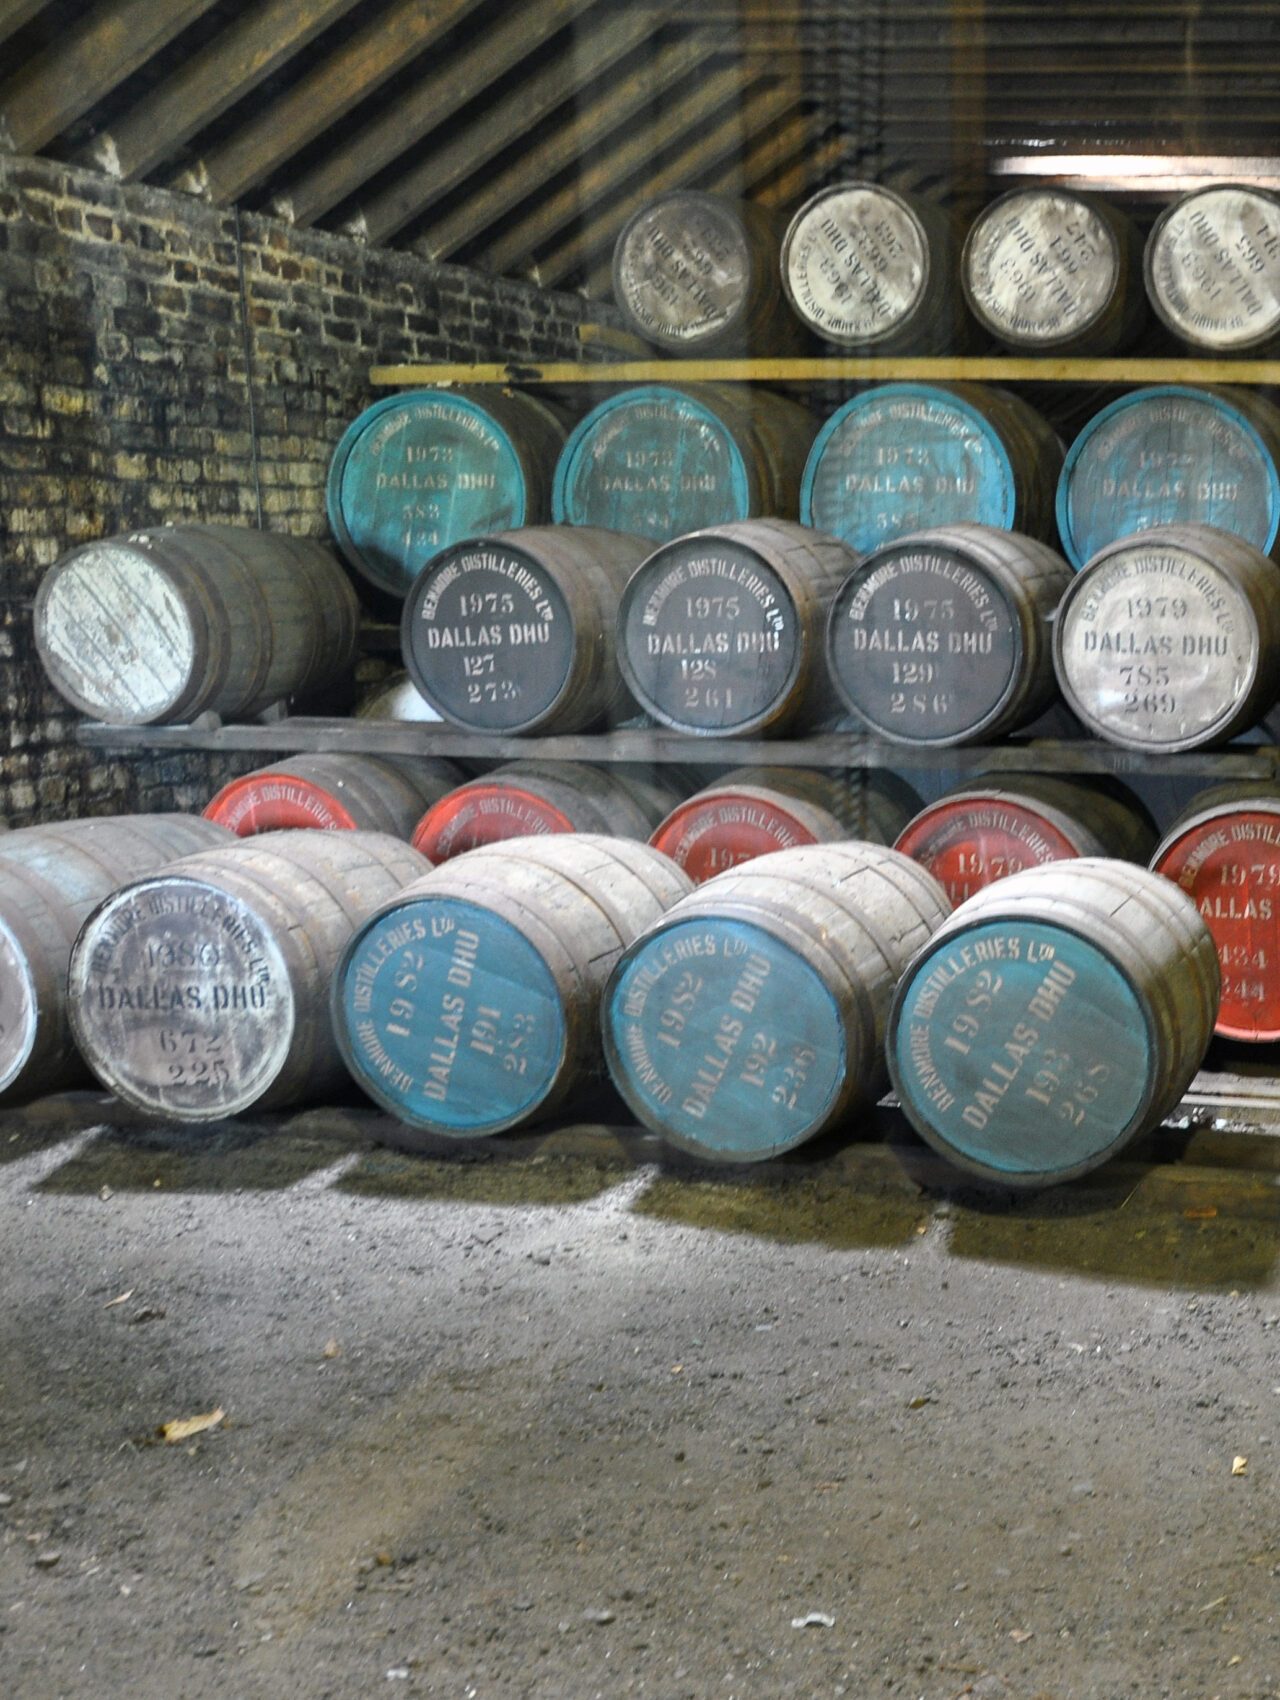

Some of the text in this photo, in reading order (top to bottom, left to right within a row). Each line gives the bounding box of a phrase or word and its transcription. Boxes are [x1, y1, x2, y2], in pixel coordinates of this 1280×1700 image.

[819, 218, 892, 315] DALLAS DHU
[1005, 216, 1079, 315] DALLAS DHU
[1186, 210, 1264, 315] DALLAS DHU
[376, 472, 495, 489] DALLAS DHU
[598, 475, 716, 492] DALLAS DHU
[845, 474, 975, 494] DALLAS DHU
[1102, 480, 1237, 501] DALLAS DHU
[420, 553, 545, 621] BENMORE DISTILLERIES
[642, 556, 775, 627] BENMORE DISTILLERIES
[849, 555, 989, 621] BENMORE DISTILLERIES
[1135, 555, 1225, 610] DISTILLERIES
[458, 591, 514, 616] 1975
[684, 595, 740, 618] 1975
[892, 597, 954, 621] 1975
[1126, 596, 1187, 618] 1979
[426, 623, 550, 648] DALLAS DHU
[646, 630, 780, 654] DALLAS DHU
[853, 627, 992, 653] DALLAS DHU
[1083, 630, 1228, 656] DALLAS DHU
[463, 654, 495, 676] 127
[1198, 896, 1271, 920] ALLAS
[915, 938, 1022, 1021] DISTILLERIES
[97, 984, 266, 1010] DALLAS DHU
[350, 916, 425, 1094] BENMORE DISTILLERIES
[421, 929, 479, 1101] DALLAS DHU
[625, 934, 717, 1105] BENMORE DISTILLERIES
[158, 1030, 222, 1053] 672
[471, 1006, 499, 1053] 191
[680, 952, 774, 1119] DALLAS DHU
[959, 957, 1079, 1133] DALLAS DHU
[912, 1020, 954, 1114] BENMORE
